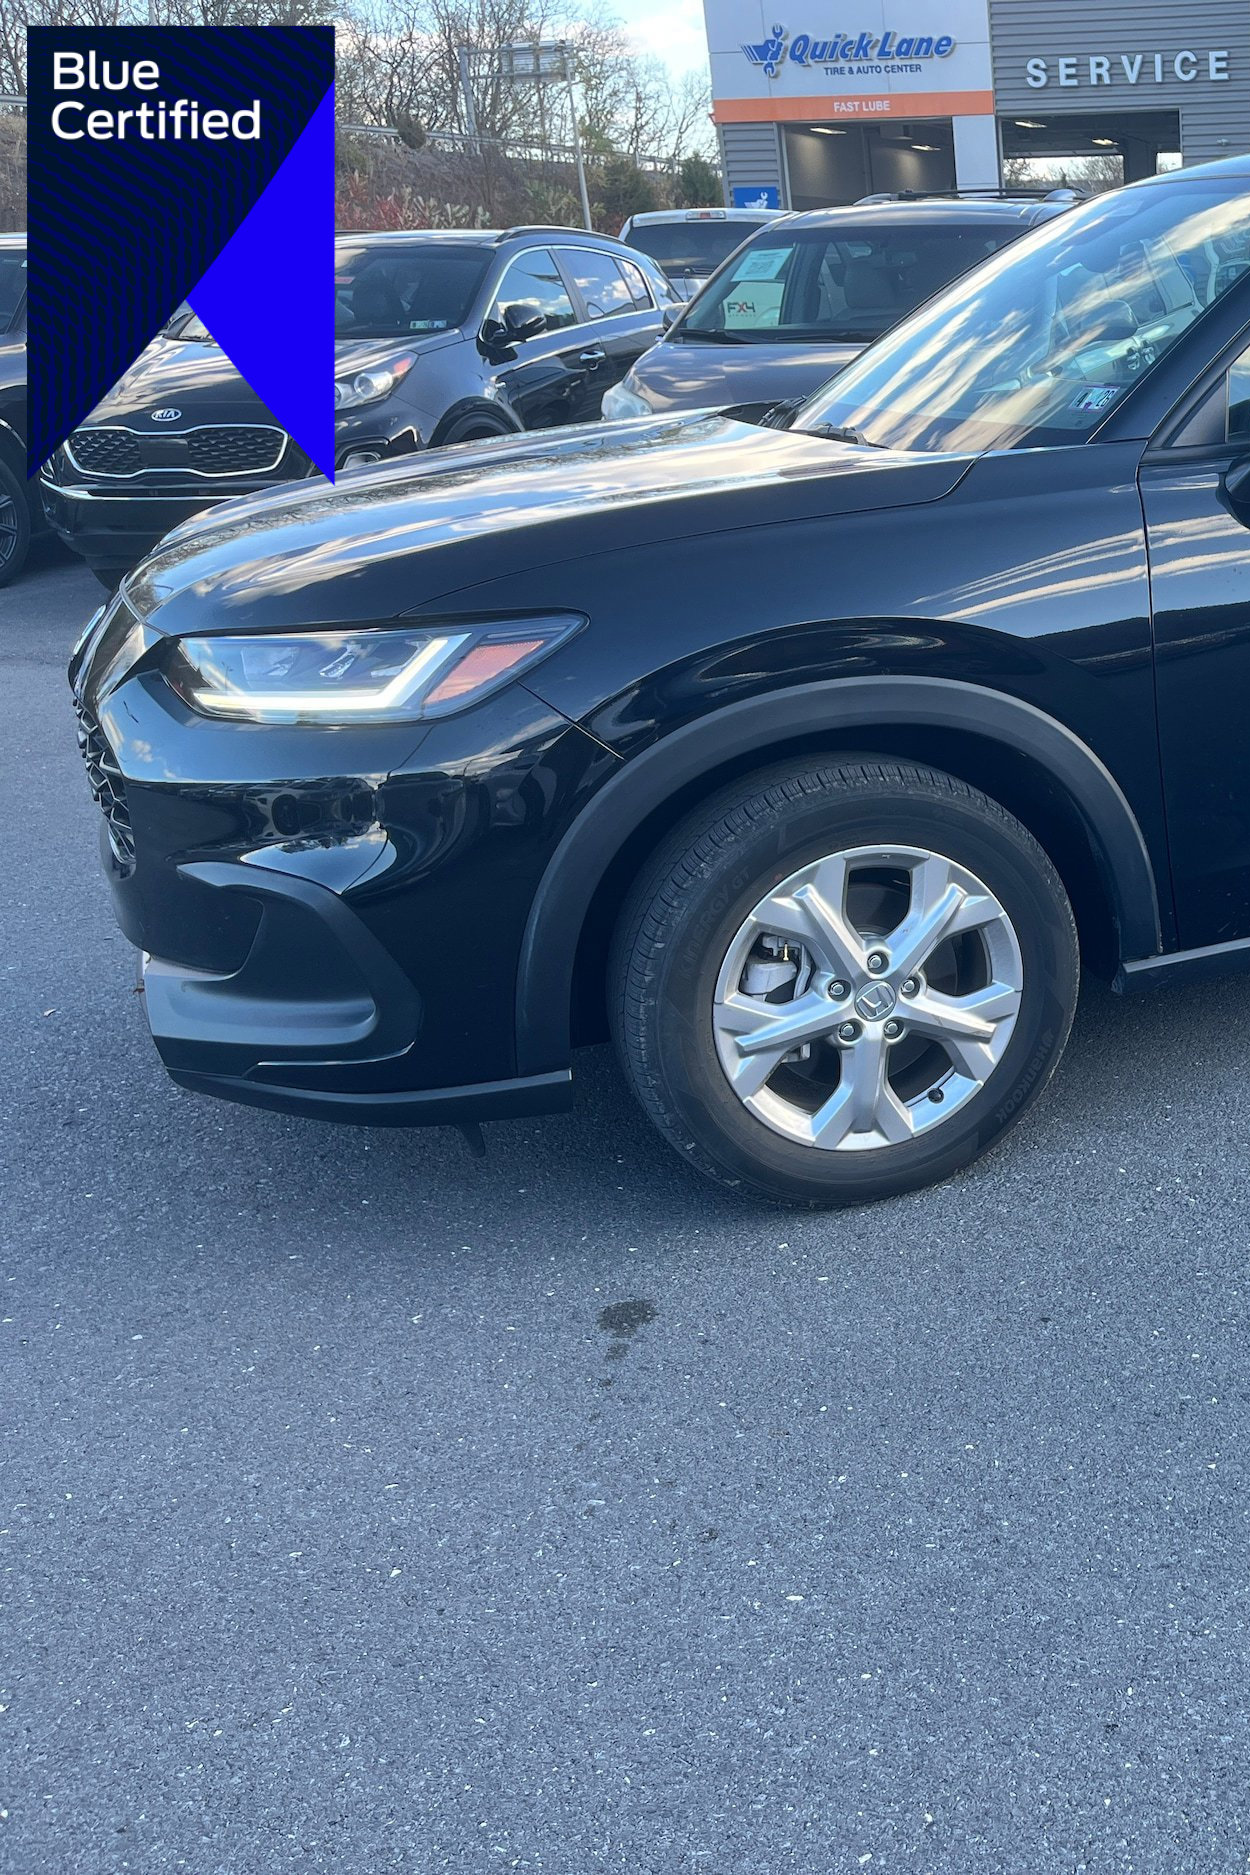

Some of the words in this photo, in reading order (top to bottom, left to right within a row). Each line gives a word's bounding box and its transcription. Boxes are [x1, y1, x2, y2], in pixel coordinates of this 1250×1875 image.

[788, 32, 874, 66] Quick
[877, 31, 954, 59] Lane
[823, 66, 845, 76] TIRE
[848, 66, 855, 75] &
[856, 65, 882, 75] AUTO
[884, 64, 922, 74] CENTER
[1026, 50, 1229, 88] SERVICE
[833, 102, 860, 112] FAST
[862, 101, 891, 111] LUBE
[727, 302, 756, 313] FX4
[155, 410, 175, 418] KIA
